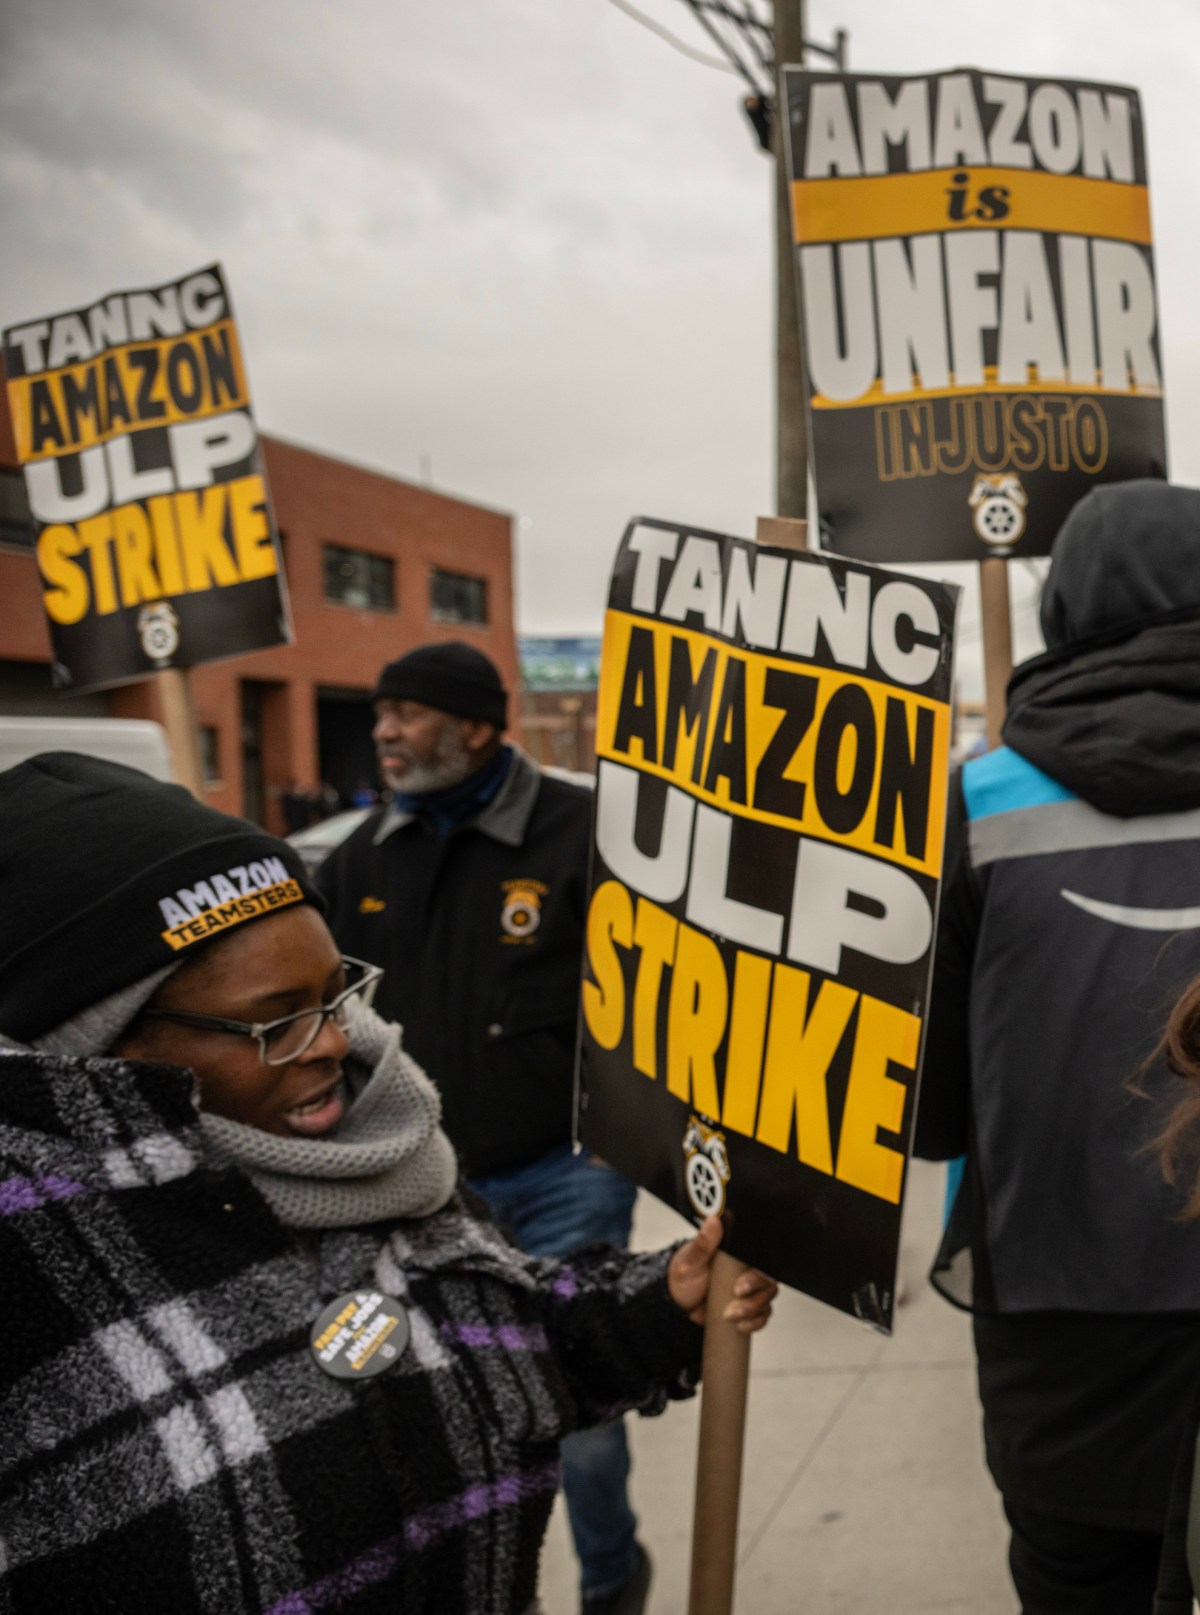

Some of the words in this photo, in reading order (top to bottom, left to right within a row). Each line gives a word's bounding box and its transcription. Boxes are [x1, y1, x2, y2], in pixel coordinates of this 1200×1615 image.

[804, 74, 1135, 184] AMAZON
[945, 172, 1011, 222] is
[8, 272, 226, 375] TANNC
[802, 229, 1163, 402] UNFAIR
[30, 325, 242, 455] AMAZON
[875, 395, 1109, 481] INJUSTO
[24, 410, 258, 525] ULP
[37, 474, 279, 626] STRIKE
[627, 524, 941, 686] TANNC
[612, 624, 936, 864] AMAZON
[158, 856, 289, 929] AMAZON
[171, 883, 298, 942] TEAMSTERS
[596, 759, 934, 976] ULP
[582, 880, 922, 1206] STRIKE
